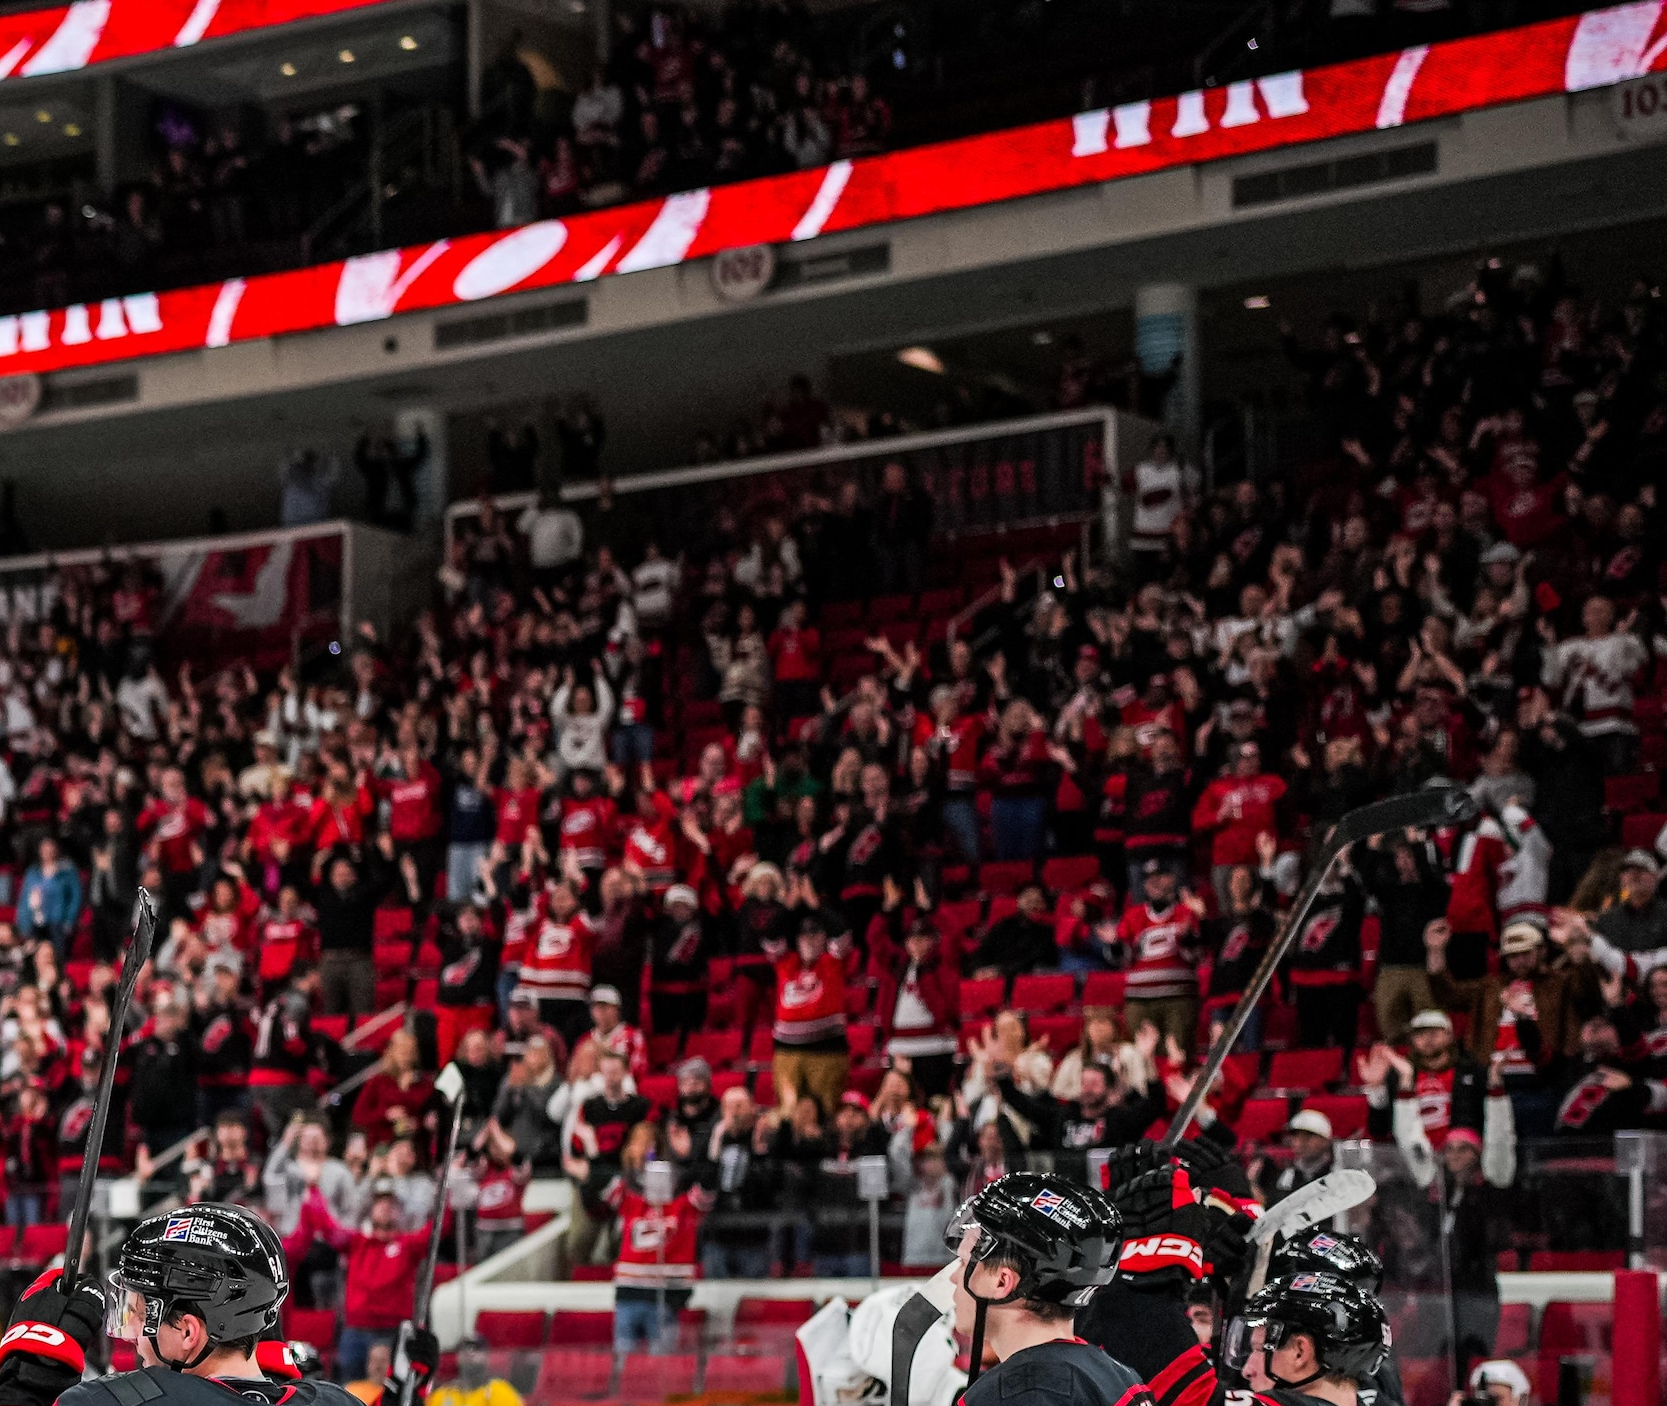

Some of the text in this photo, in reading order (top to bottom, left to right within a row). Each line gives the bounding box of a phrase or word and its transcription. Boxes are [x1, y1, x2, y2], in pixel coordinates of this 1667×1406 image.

[192, 1217, 215, 1228] First
[1050, 1212, 1072, 1230] Bank
[190, 1225, 228, 1239] Citizens
[188, 1234, 213, 1246] Bank
